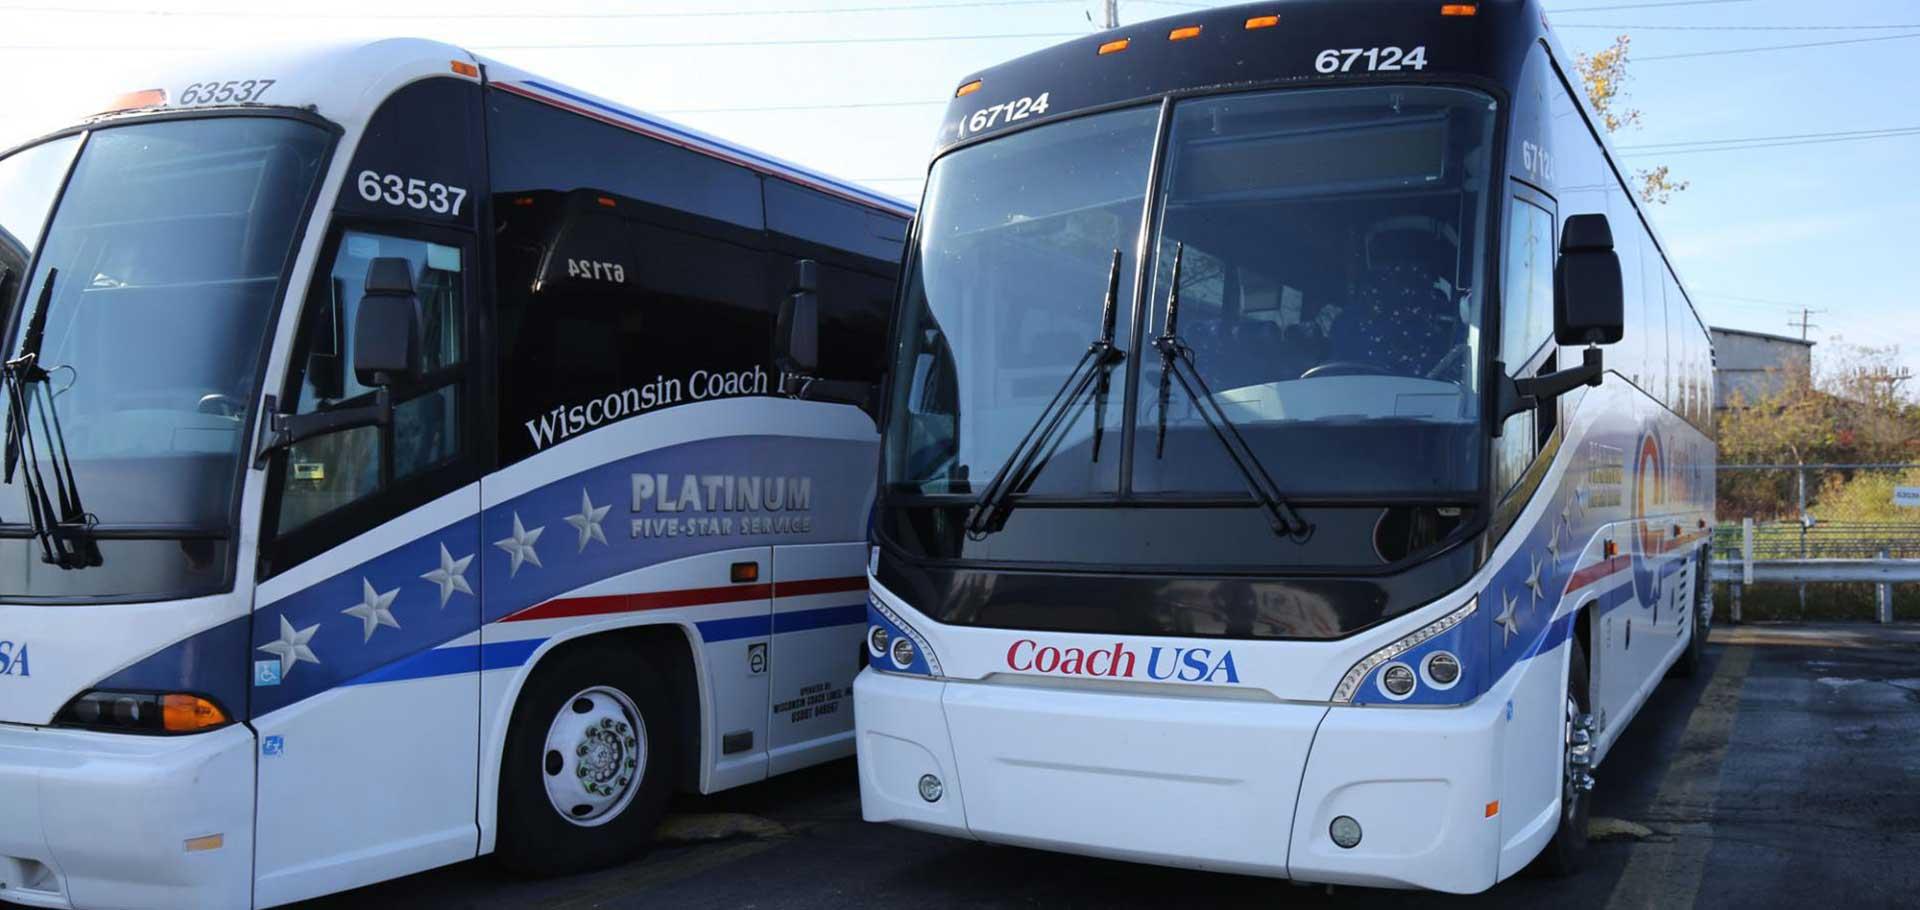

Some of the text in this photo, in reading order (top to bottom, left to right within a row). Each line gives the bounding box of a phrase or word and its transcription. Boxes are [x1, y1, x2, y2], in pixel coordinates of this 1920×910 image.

[1314, 46, 1427, 74] 67124
[180, 79, 276, 105] 63537
[969, 92, 1050, 134] 67124
[1523, 140, 1557, 180] 6712
[358, 170, 467, 216] 63537
[525, 374, 682, 450] Wisconsin
[689, 364, 769, 398] Coach
[631, 473, 812, 513] PLATINUM
[741, 516, 812, 535] SERVICE
[1007, 639, 1240, 684] Coach USA
